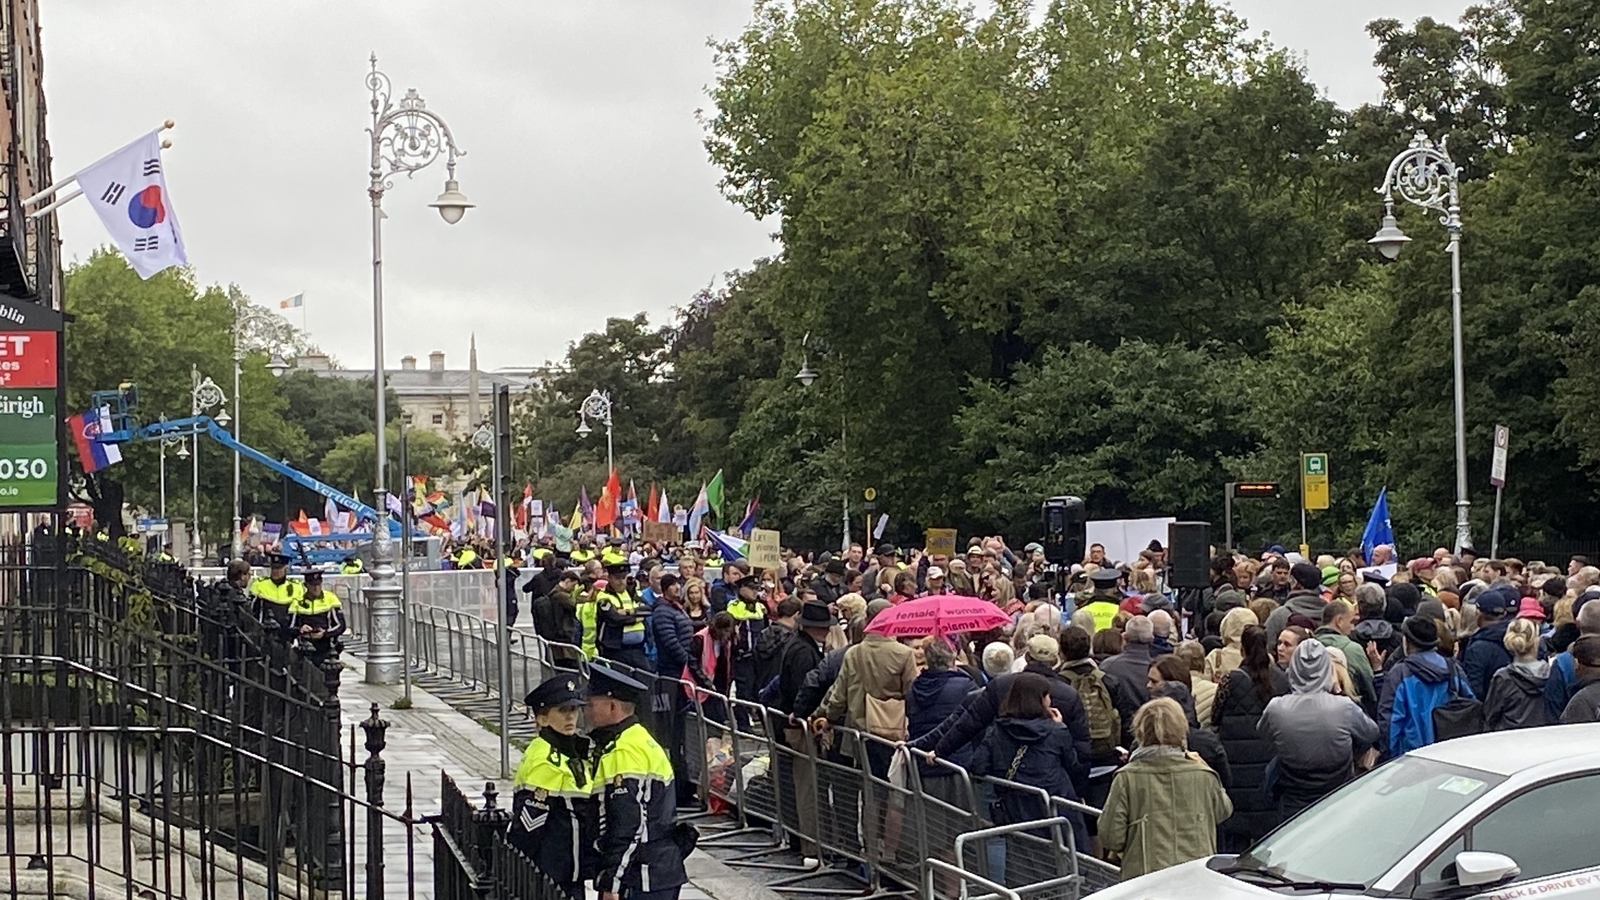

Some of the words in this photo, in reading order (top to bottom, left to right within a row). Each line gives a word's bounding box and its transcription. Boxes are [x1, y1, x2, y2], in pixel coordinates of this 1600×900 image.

[896, 609, 935, 620] female
[945, 607, 986, 615] woman
[1538, 879, 1576, 893] DRIVE
